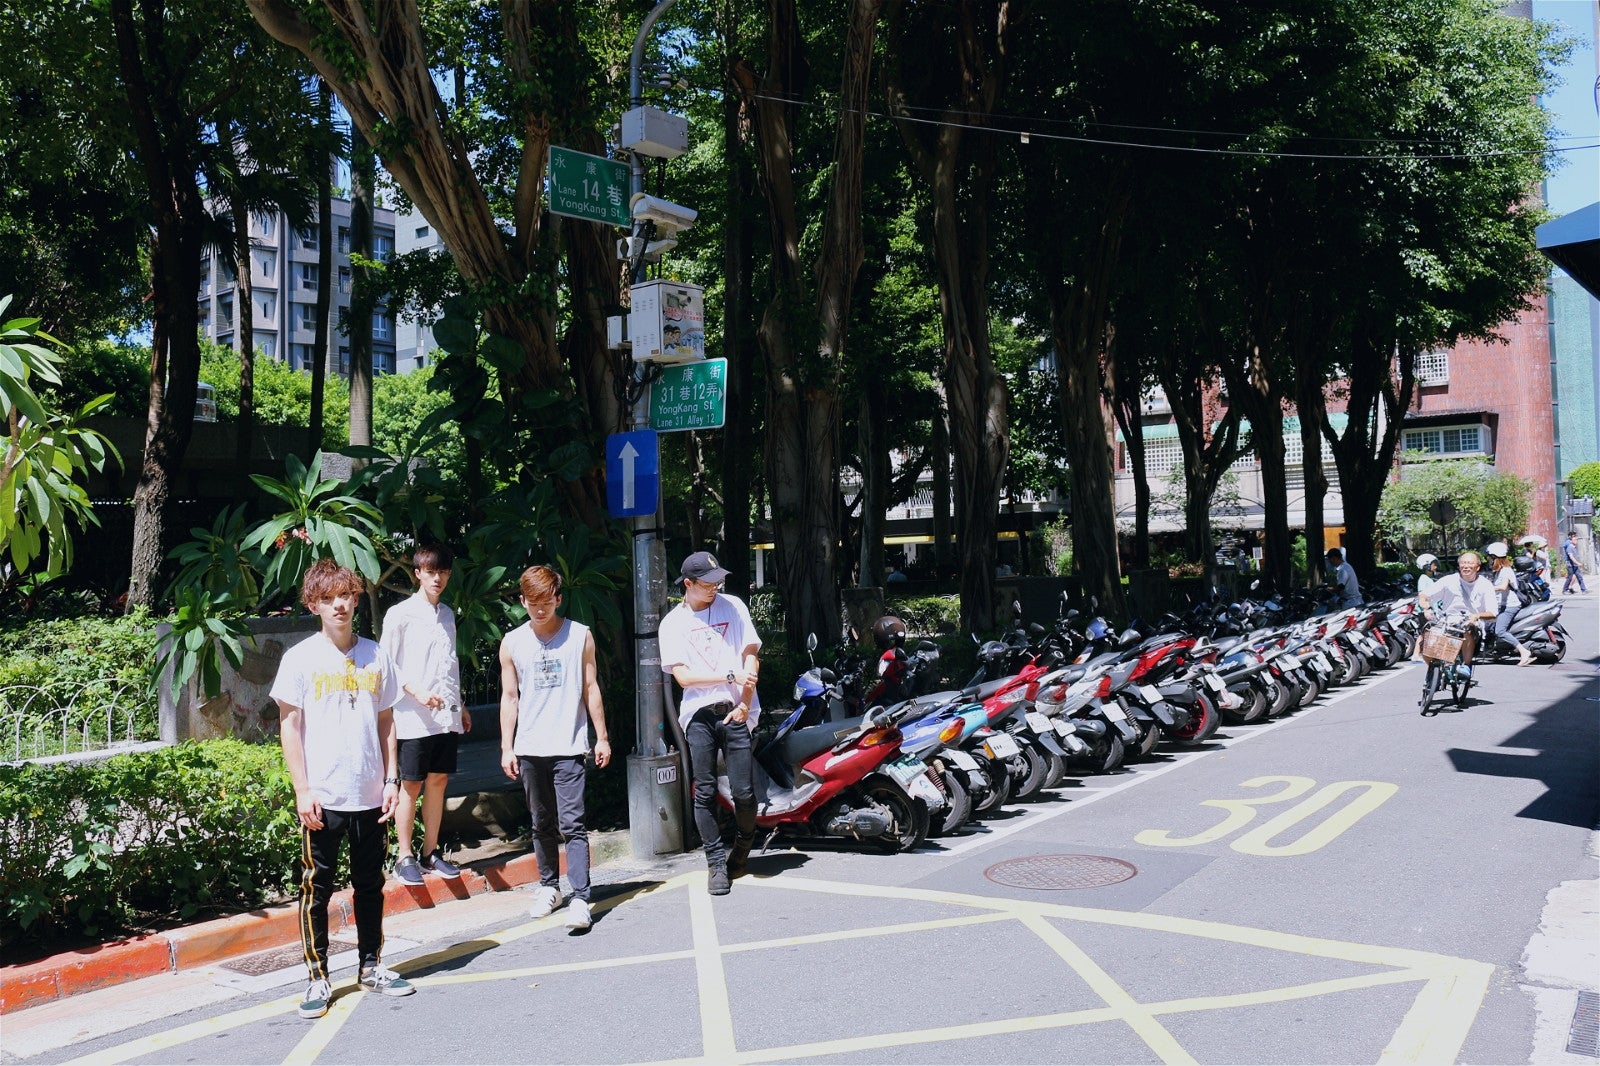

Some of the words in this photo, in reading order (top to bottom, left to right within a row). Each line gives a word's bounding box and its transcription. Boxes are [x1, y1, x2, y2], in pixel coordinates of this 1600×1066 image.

[554, 154, 626, 182] 永康街
[558, 184, 577, 197] Lane
[560, 197, 607, 218] YongKang
[658, 403, 698, 415] YongKang
[657, 417, 673, 428] Lane
[676, 415, 684, 425] 31
[687, 414, 704, 426] Alley
[707, 413, 715, 424] 12
[1133, 775, 1400, 857] 30
